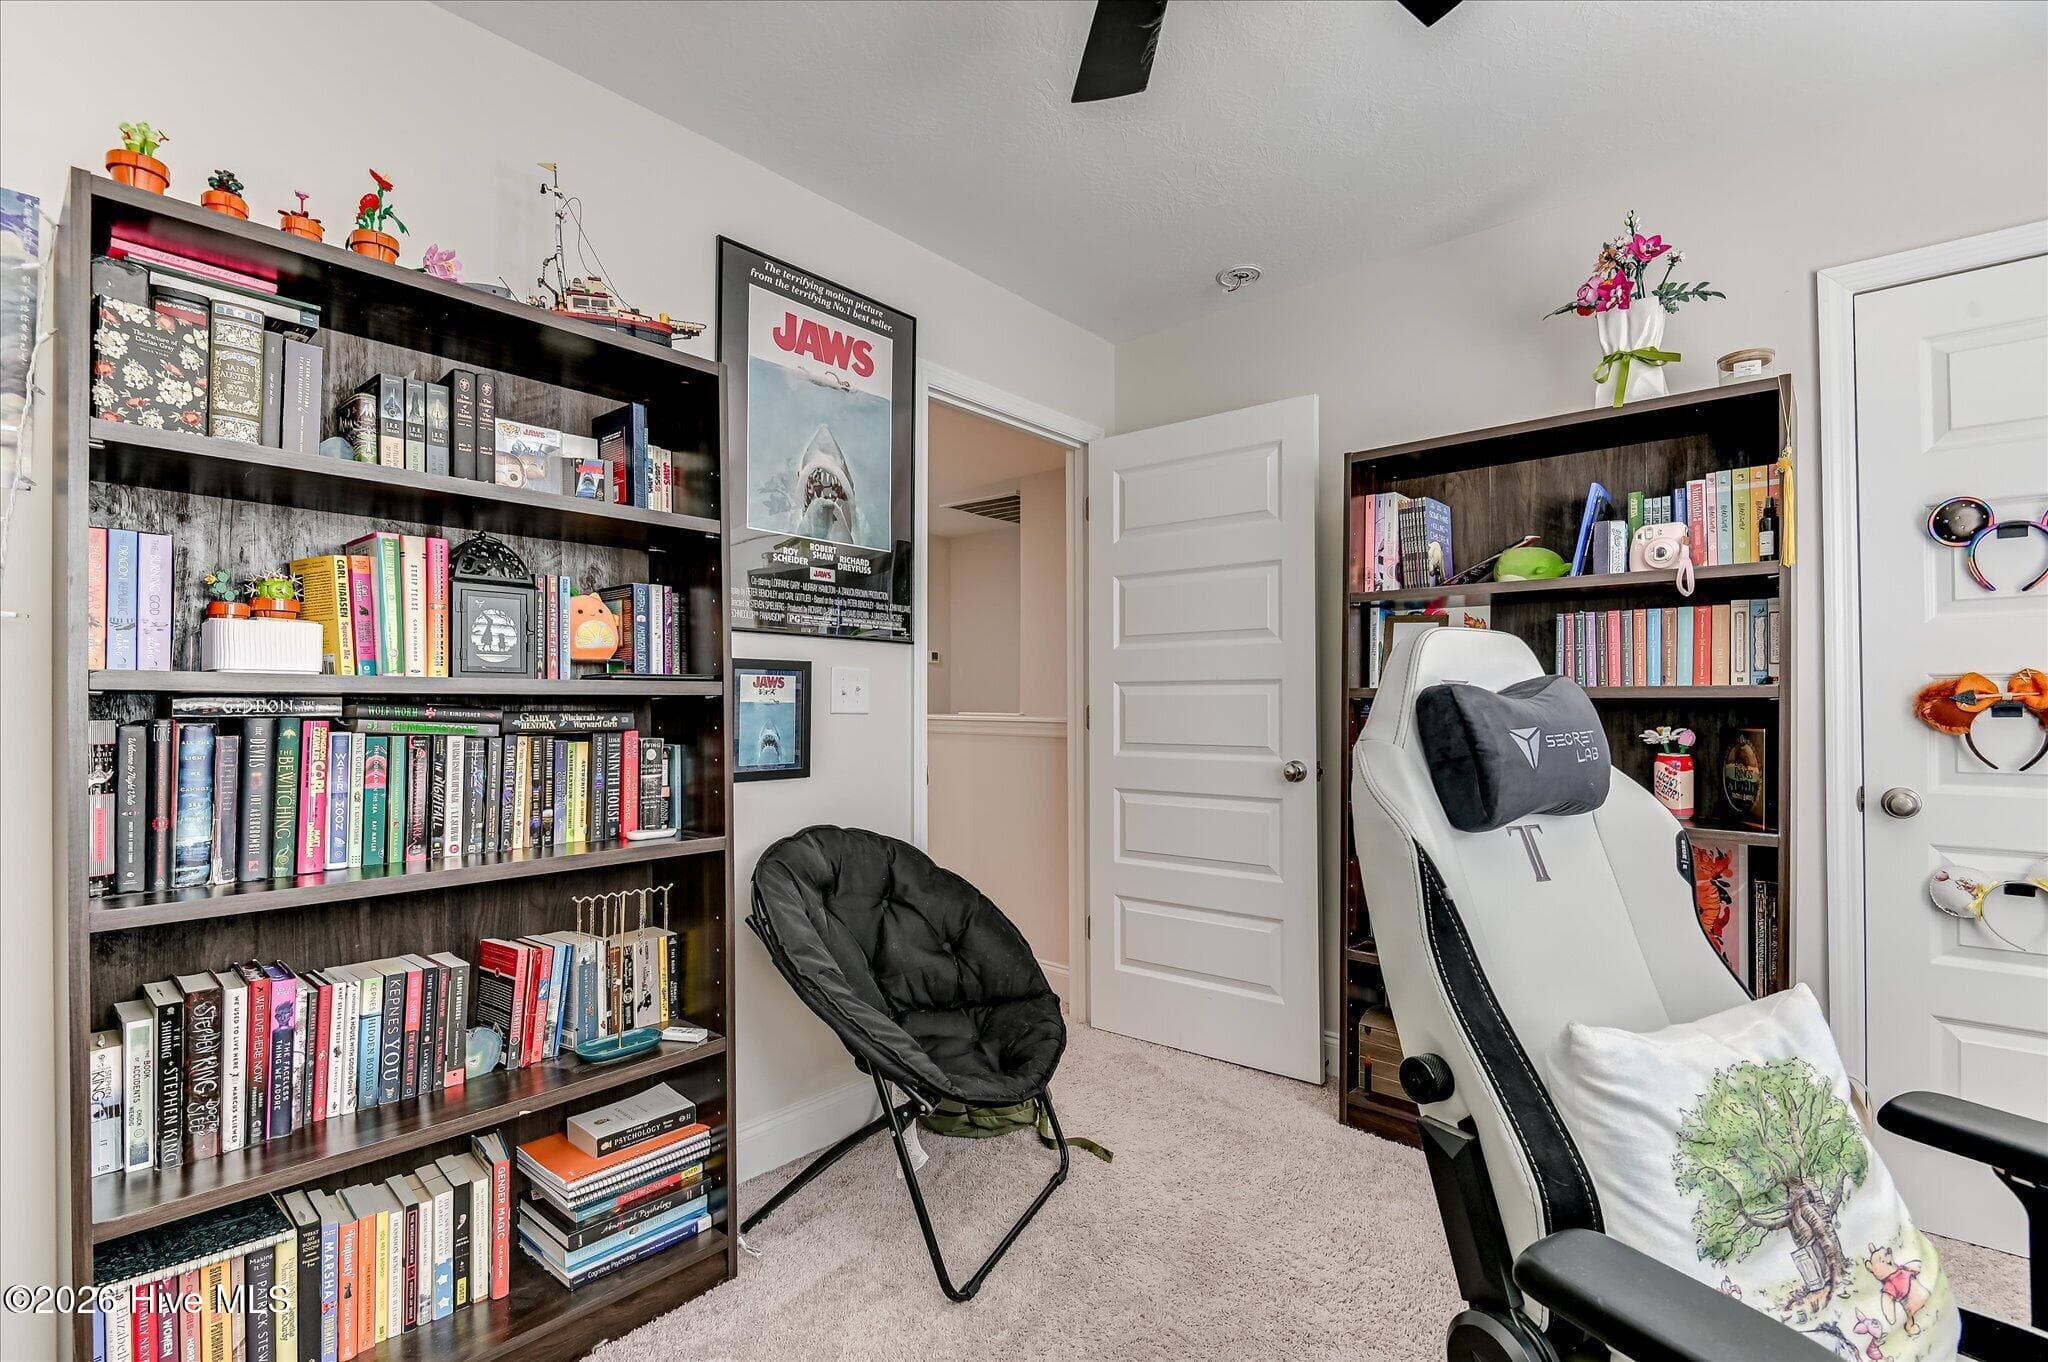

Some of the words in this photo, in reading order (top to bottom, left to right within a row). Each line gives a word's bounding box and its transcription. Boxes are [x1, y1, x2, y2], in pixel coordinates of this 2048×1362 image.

[750, 267, 774, 286] from
[775, 278, 790, 292] the
[791, 286, 832, 310] terrifying
[852, 308, 870, 324] best
[870, 315, 894, 332] seller.
[764, 261, 782, 276] The
[782, 270, 824, 295] terrifying
[825, 288, 854, 306] motion
[855, 298, 884, 318] picture
[132, 328, 148, 337] The
[149, 330, 170, 344] Picture
[135, 335, 158, 348] Dorian
[159, 342, 176, 354] Gray
[772, 312, 875, 378] JAWS
[220, 372, 254, 383] AUSTEN
[226, 363, 250, 375] JANE
[224, 388, 250, 398] NOVELS
[523, 428, 546, 439] JAWS
[385, 540, 395, 560] CARL
[772, 553, 809, 566] SCHEIDER
[782, 546, 799, 556] ROY
[809, 543, 837, 555] ROBERT
[812, 551, 834, 562] SHAW
[118, 545, 129, 580] DRAGON
[149, 554, 160, 592] BURNING
[337, 559, 346, 580] CARL
[838, 562, 872, 575] DREYFUSS
[839, 556, 870, 568] RICHARD
[410, 564, 418, 586] STRIP
[813, 570, 832, 580] JAWS
[149, 594, 160, 616] GOD
[338, 582, 349, 618] HIAASEN
[410, 588, 418, 612] TEASE
[789, 615, 801, 624] PG
[340, 621, 350, 648] Squeeze
[638, 653, 646, 672] GODS
[752, 676, 785, 689] JAWS
[222, 699, 294, 715] GIDEON
[368, 705, 390, 716] WOLF
[394, 706, 418, 717] WORM
[520, 712, 550, 721] GRADY
[559, 713, 596, 722] Witchcraft
[520, 720, 556, 730] HENDRIX
[573, 720, 602, 728] Wayward
[602, 720, 618, 728] Girls
[312, 726, 320, 760] CRAWLER
[320, 726, 328, 760] DUNGEON
[1545, 730, 1595, 748] SECRET
[248, 736, 266, 768] DEVILS
[505, 744, 515, 774] STRANGE
[1576, 748, 1600, 763] LAB
[335, 752, 346, 792] WATER
[434, 762, 443, 772] IN
[608, 752, 620, 785] NINTH
[311, 760, 326, 797] CARL
[1656, 770, 1681, 790] LUCKY
[250, 794, 262, 807] JOE
[275, 756, 294, 840] BEWITCHING
[432, 774, 444, 830] NIGHTFALL
[1655, 780, 1684, 802] CHERRY
[335, 800, 345, 832] MOON
[607, 788, 619, 823] HOUSE
[248, 809, 260, 855] ABERCROMBIE
[306, 822, 315, 858] DINNIMAN
[234, 995, 240, 1004] WE
[255, 995, 264, 1011] WE
[387, 979, 401, 1035] KEPNES
[192, 1001, 220, 1057] STEPHEN
[233, 1026, 239, 1035] TO
[254, 1012, 264, 1034] LIVE
[161, 1020, 172, 1059] SHINING
[254, 1034, 264, 1059] HERE
[367, 1019, 376, 1055] HIDDEN
[144, 1060, 152, 1079] BOOK
[383, 1037, 400, 1081] YOU
[190, 1056, 220, 1094] KING
[253, 1060, 262, 1083] NOW
[274, 1068, 282, 1080] WE
[365, 1059, 374, 1092] BODIES
[92, 1070, 106, 1102] KING
[163, 1068, 178, 1126] STEPHEN
[187, 1100, 205, 1136] SLEEP
[205, 1098, 220, 1134] DOCTOR
[101, 1140, 107, 1148] IT
[614, 1124, 660, 1146] PSYCHOLOGY
[164, 1130, 178, 1163] KING
[498, 1166, 506, 1204] GENDER
[497, 1207, 506, 1240] MAGIC
[601, 1212, 638, 1234] Abnormal
[639, 1200, 672, 1220] Psychology
[250, 1254, 273, 1264] Making
[588, 1264, 610, 1279] Cognitive
[610, 1252, 638, 1272] Psychology
[324, 1241, 335, 1300] MARSHA
[161, 1318, 173, 1358] WOMEN
